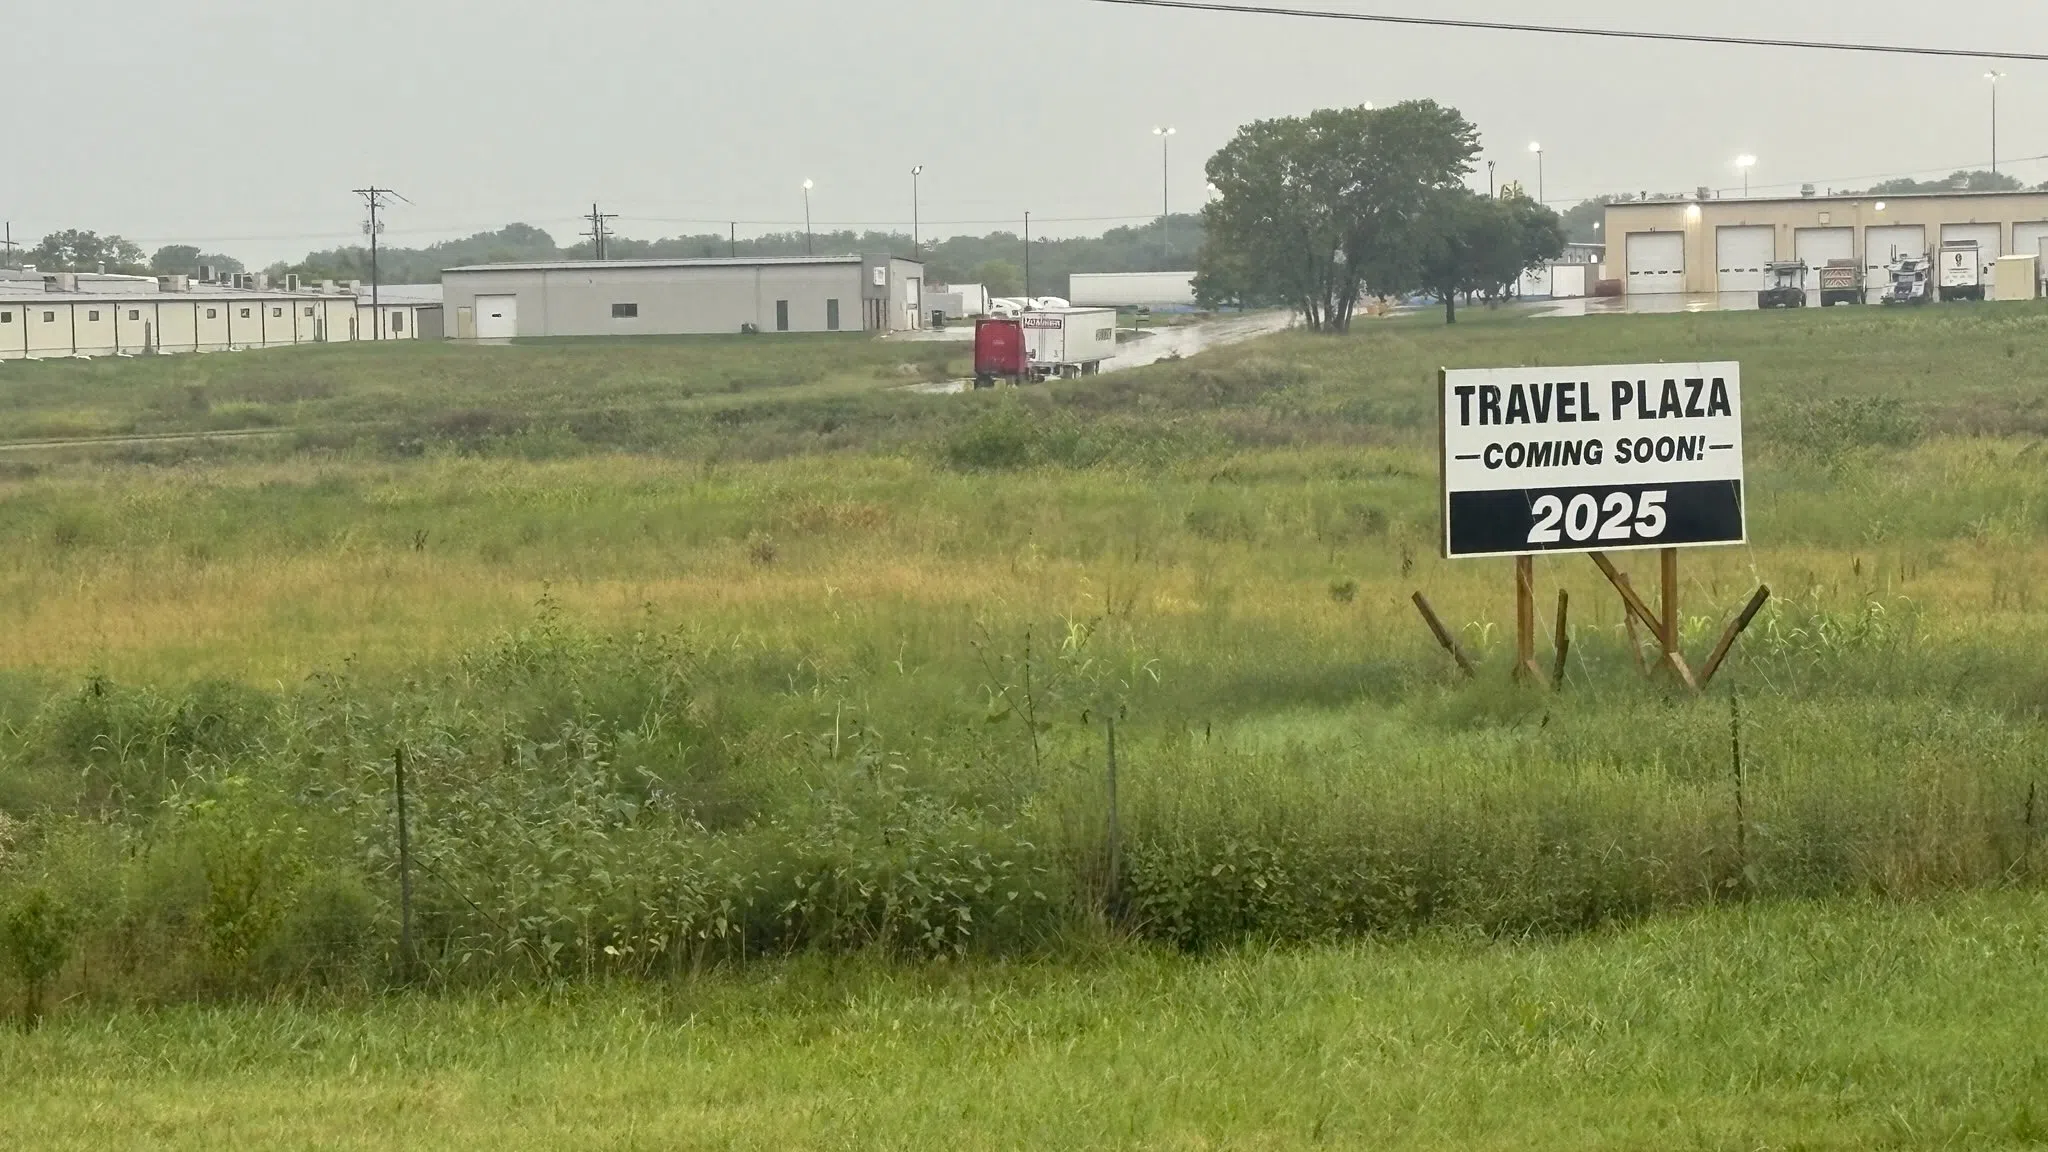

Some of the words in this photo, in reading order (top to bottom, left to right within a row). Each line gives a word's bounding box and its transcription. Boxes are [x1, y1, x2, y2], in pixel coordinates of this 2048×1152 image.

[1455, 381, 1600, 426] TRAVEL
[1611, 377, 1732, 421] PLAZA
[1483, 438, 1604, 470] COMING
[1614, 435, 1706, 464] SOON!
[1526, 490, 1668, 544] 2025
